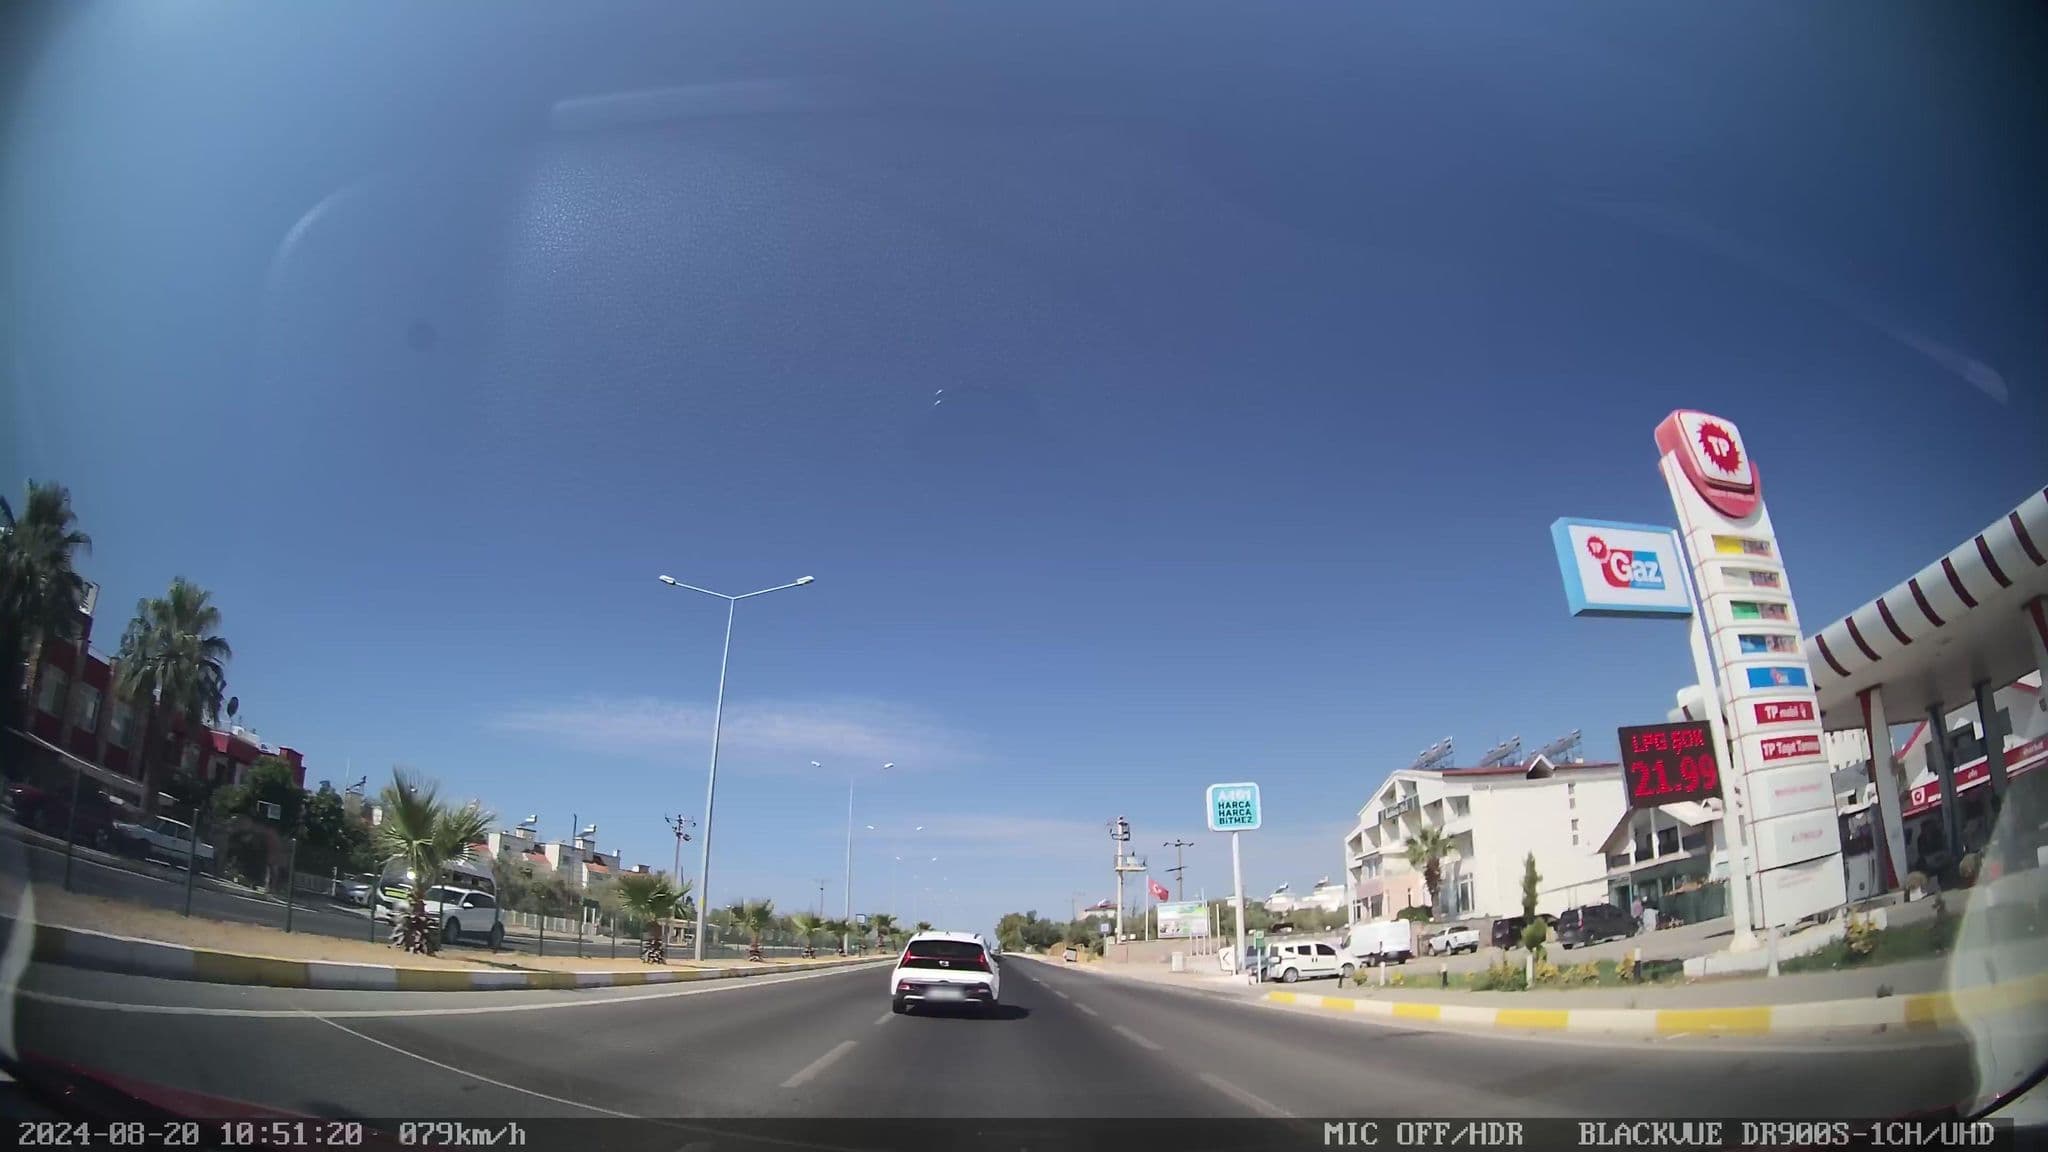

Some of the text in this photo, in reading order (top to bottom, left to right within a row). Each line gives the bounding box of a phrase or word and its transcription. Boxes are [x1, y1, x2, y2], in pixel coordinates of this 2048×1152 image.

[1707, 434, 1730, 458] TP
[1609, 550, 1663, 583] Gaz
[1764, 705, 1779, 720] TP
[1632, 732, 1668, 752] LPG
[1762, 741, 1776, 757] TP
[1632, 755, 1718, 797] 21.99
[1218, 800, 1251, 809] HARCA
[1219, 808, 1252, 817] HARCA
